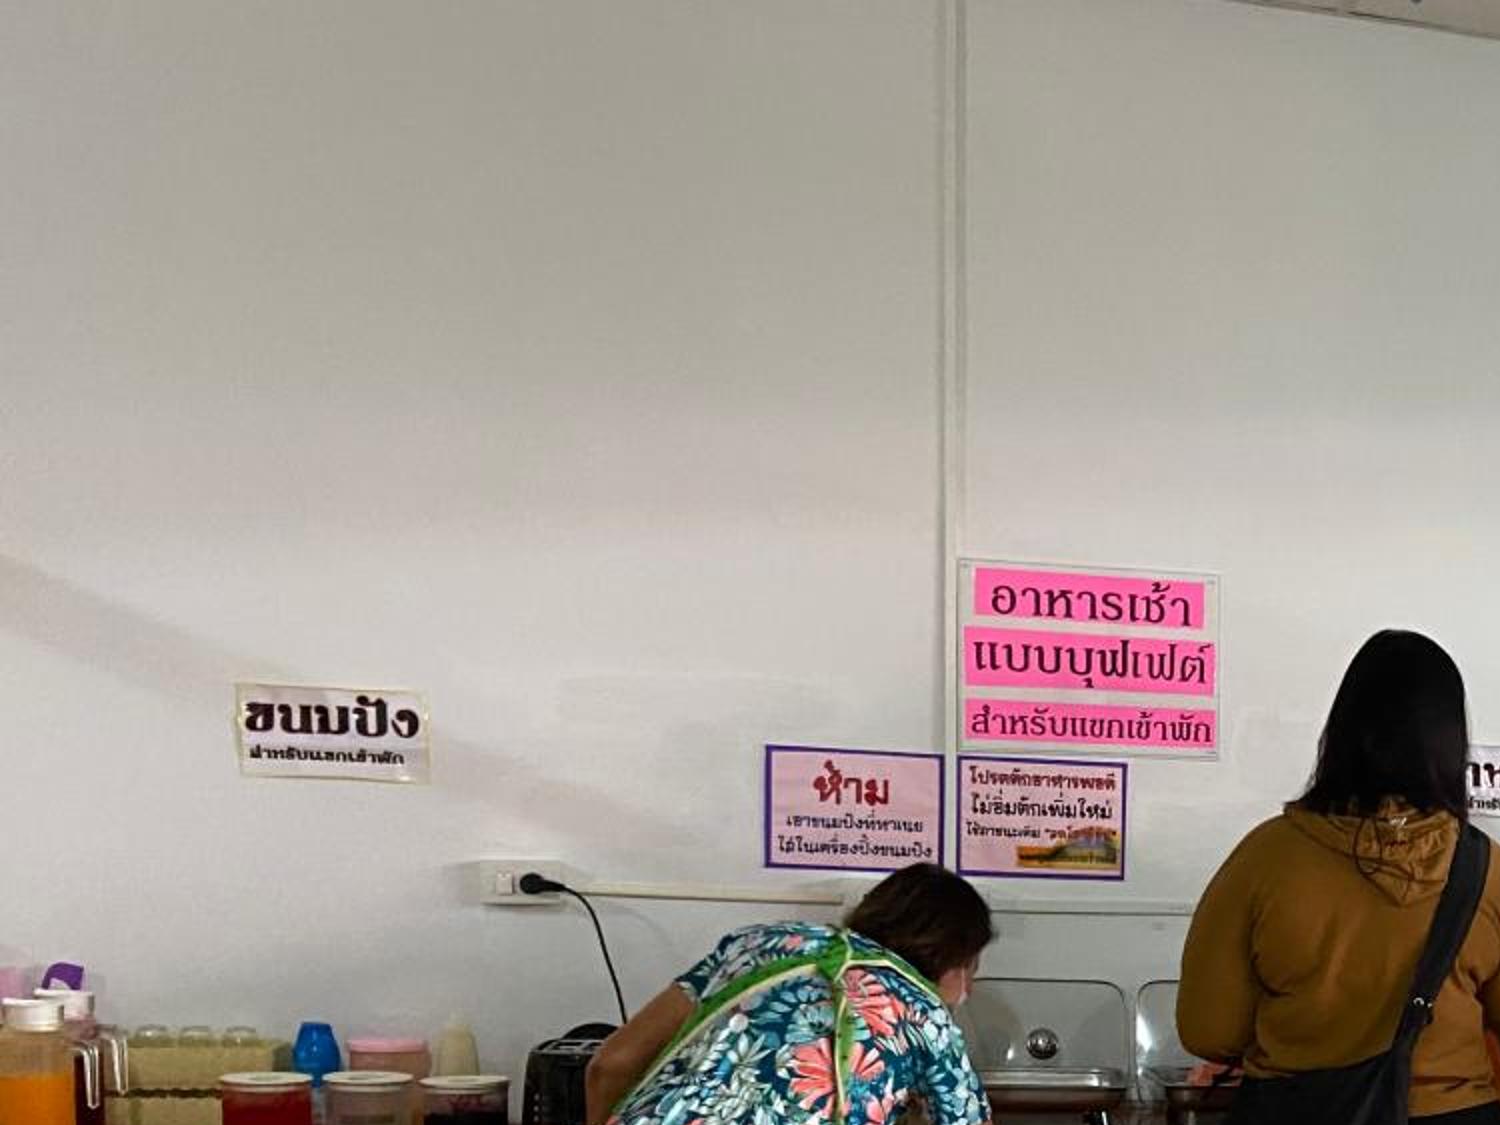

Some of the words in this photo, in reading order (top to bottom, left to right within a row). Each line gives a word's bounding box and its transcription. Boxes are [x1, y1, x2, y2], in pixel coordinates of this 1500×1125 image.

[991, 582, 1191, 626] อาหารเช้า
[973, 640, 1214, 688] แบบบุฟเฟต์
[245, 695, 419, 738] ขนมปัง
[972, 704, 1212, 743] สำหรับแขกเข้าพัก
[813, 760, 889, 806] ห้าม
